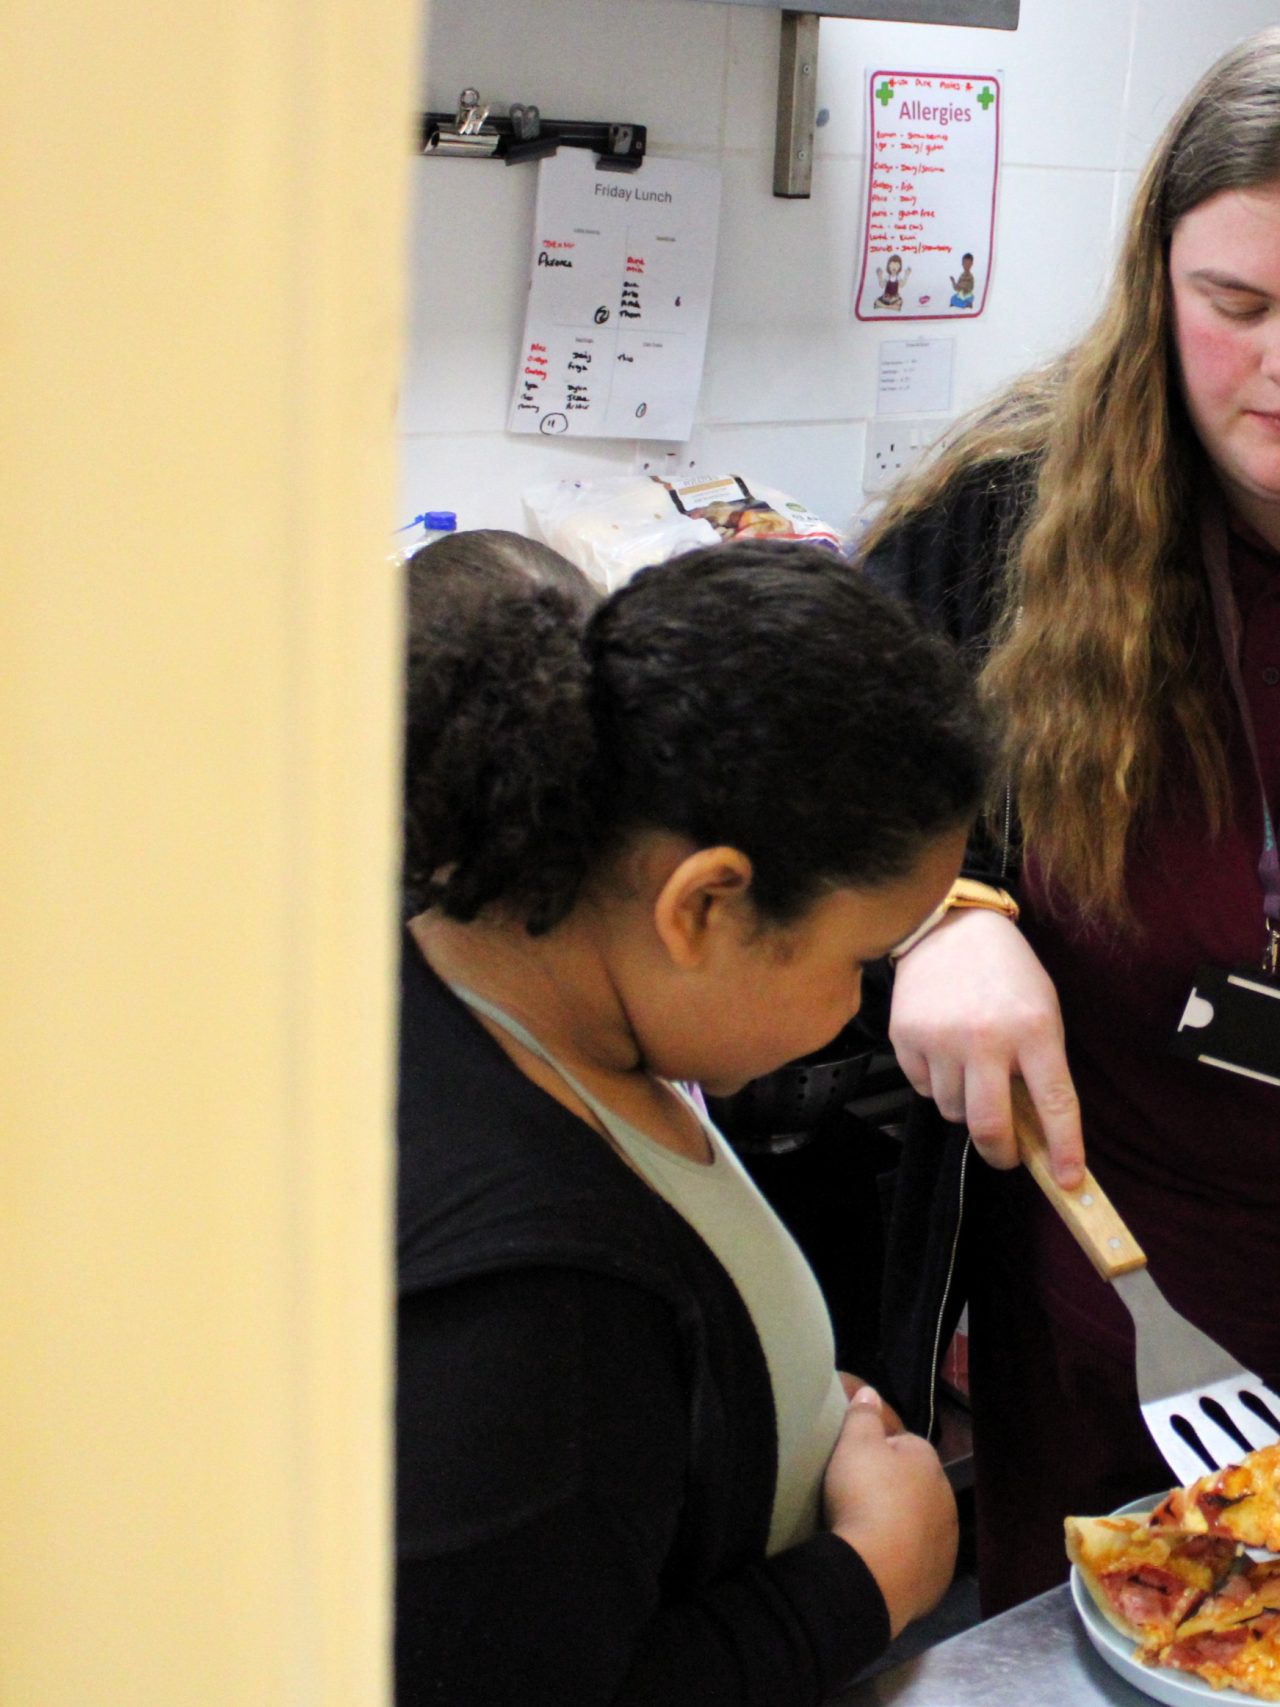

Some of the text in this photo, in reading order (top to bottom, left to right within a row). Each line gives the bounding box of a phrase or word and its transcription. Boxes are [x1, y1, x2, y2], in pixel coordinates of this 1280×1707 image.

[899, 100, 972, 126] Allergies
[594, 183, 672, 203] Friday Lunch
